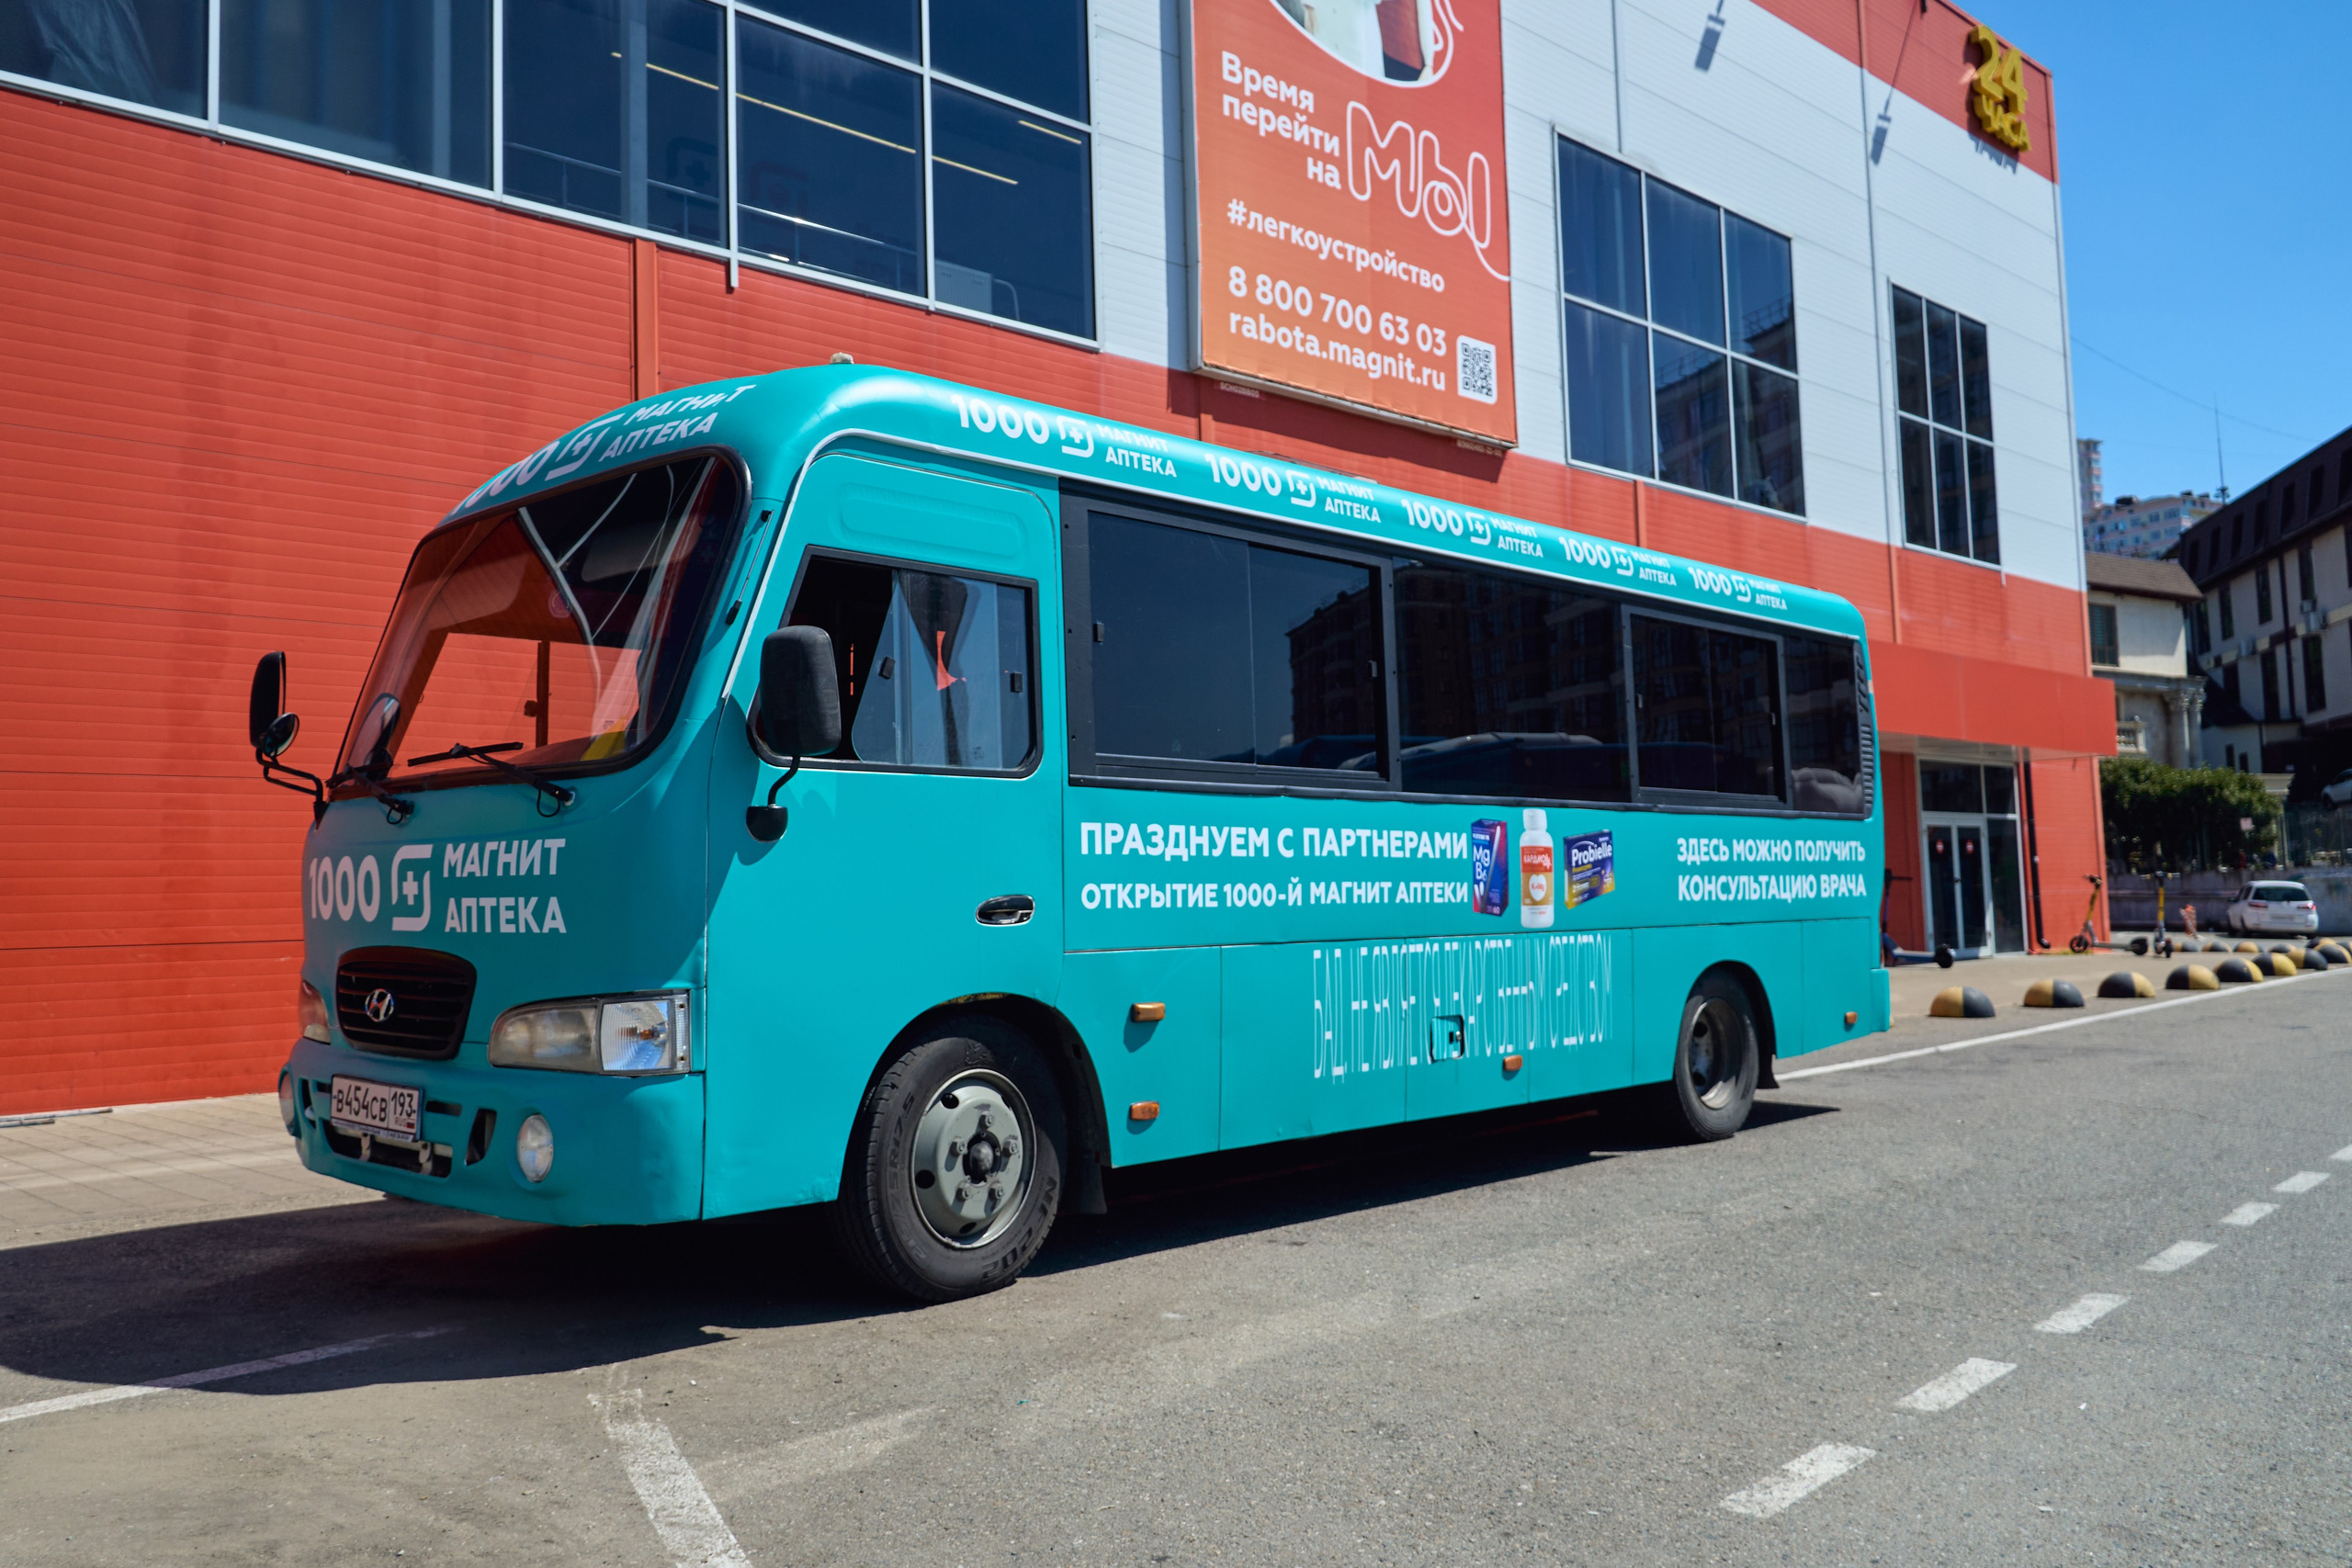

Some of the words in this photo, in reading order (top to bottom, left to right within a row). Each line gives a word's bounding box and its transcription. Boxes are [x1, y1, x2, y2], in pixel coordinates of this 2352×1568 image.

[1222, 51, 1315, 112] Время
[1970, 25, 2029, 114] 24
[1223, 94, 1340, 157] перейти
[1307, 157, 1342, 189] на
[1227, 199, 1445, 292] #легкоустройство
[1228, 266, 1247, 297] 8
[1256, 275, 1313, 316] 800
[1320, 292, 1372, 333] 700
[1380, 311, 1410, 345] 63
[1417, 322, 1446, 356] 03
[1229, 311, 1445, 391] rabota.magnit.ru
[624, 384, 756, 425] МАГНИТ
[951, 394, 1049, 445] 1000
[598, 412, 718, 461] АПТЕКА
[1096, 423, 1169, 453] МАГНИТ
[1105, 446, 1177, 478] АПТЕКА
[1204, 453, 1283, 497] 1000
[1317, 476, 1375, 501] МАГНИТ
[1324, 496, 1382, 524] АПТЕКА
[1401, 499, 1464, 536] 1000
[1491, 516, 1538, 539] МАГНИТ
[1498, 536, 1544, 558] АПТЕКА
[1559, 536, 1611, 569] 1000
[1630, 550, 1671, 570] МАГНИТ
[1639, 567, 1677, 587] АПТЕКА
[1688, 566, 1732, 597] 1000
[1755, 592, 1788, 610] АПТЕКА
[443, 838, 566, 877] МАГНИТ
[1080, 822, 1269, 862] ПРАЗДНУЕМ
[1277, 828, 1294, 858] С
[1303, 828, 1467, 859] ПАРТНЕРАМИ
[1473, 845, 1490, 867] Mg
[1572, 841, 1612, 866] Probielle
[1677, 838, 1729, 865] ЗДЕСЬ
[1733, 839, 1791, 862] МОЖНО
[1795, 840, 1866, 862] ПОЛУЧИТЬ
[310, 855, 380, 922] 1000
[1080, 883, 1217, 909] ОТКРЫТИЕ
[1224, 876, 1302, 907] 1000-Й
[1310, 882, 1392, 904] МАГНИТ
[1396, 881, 1467, 904] АПТЕКИ
[1679, 874, 1817, 903] КОНСУЛЬТАЦИЮ
[1820, 874, 1867, 897] ВРАЧА
[445, 897, 567, 933] АПТЕКА
[1351, 946, 1369, 1072] НЕ
[1373, 942, 1440, 1070] ЯВЛЯЕТСЯ
[1441, 939, 1545, 1058] ЛЕКАРСТВЕННЫМ
[1549, 932, 1612, 1053] СРЕДСТВОМ
[336, 1085, 387, 1122] В454СВ
[391, 1091, 413, 1117] 193
